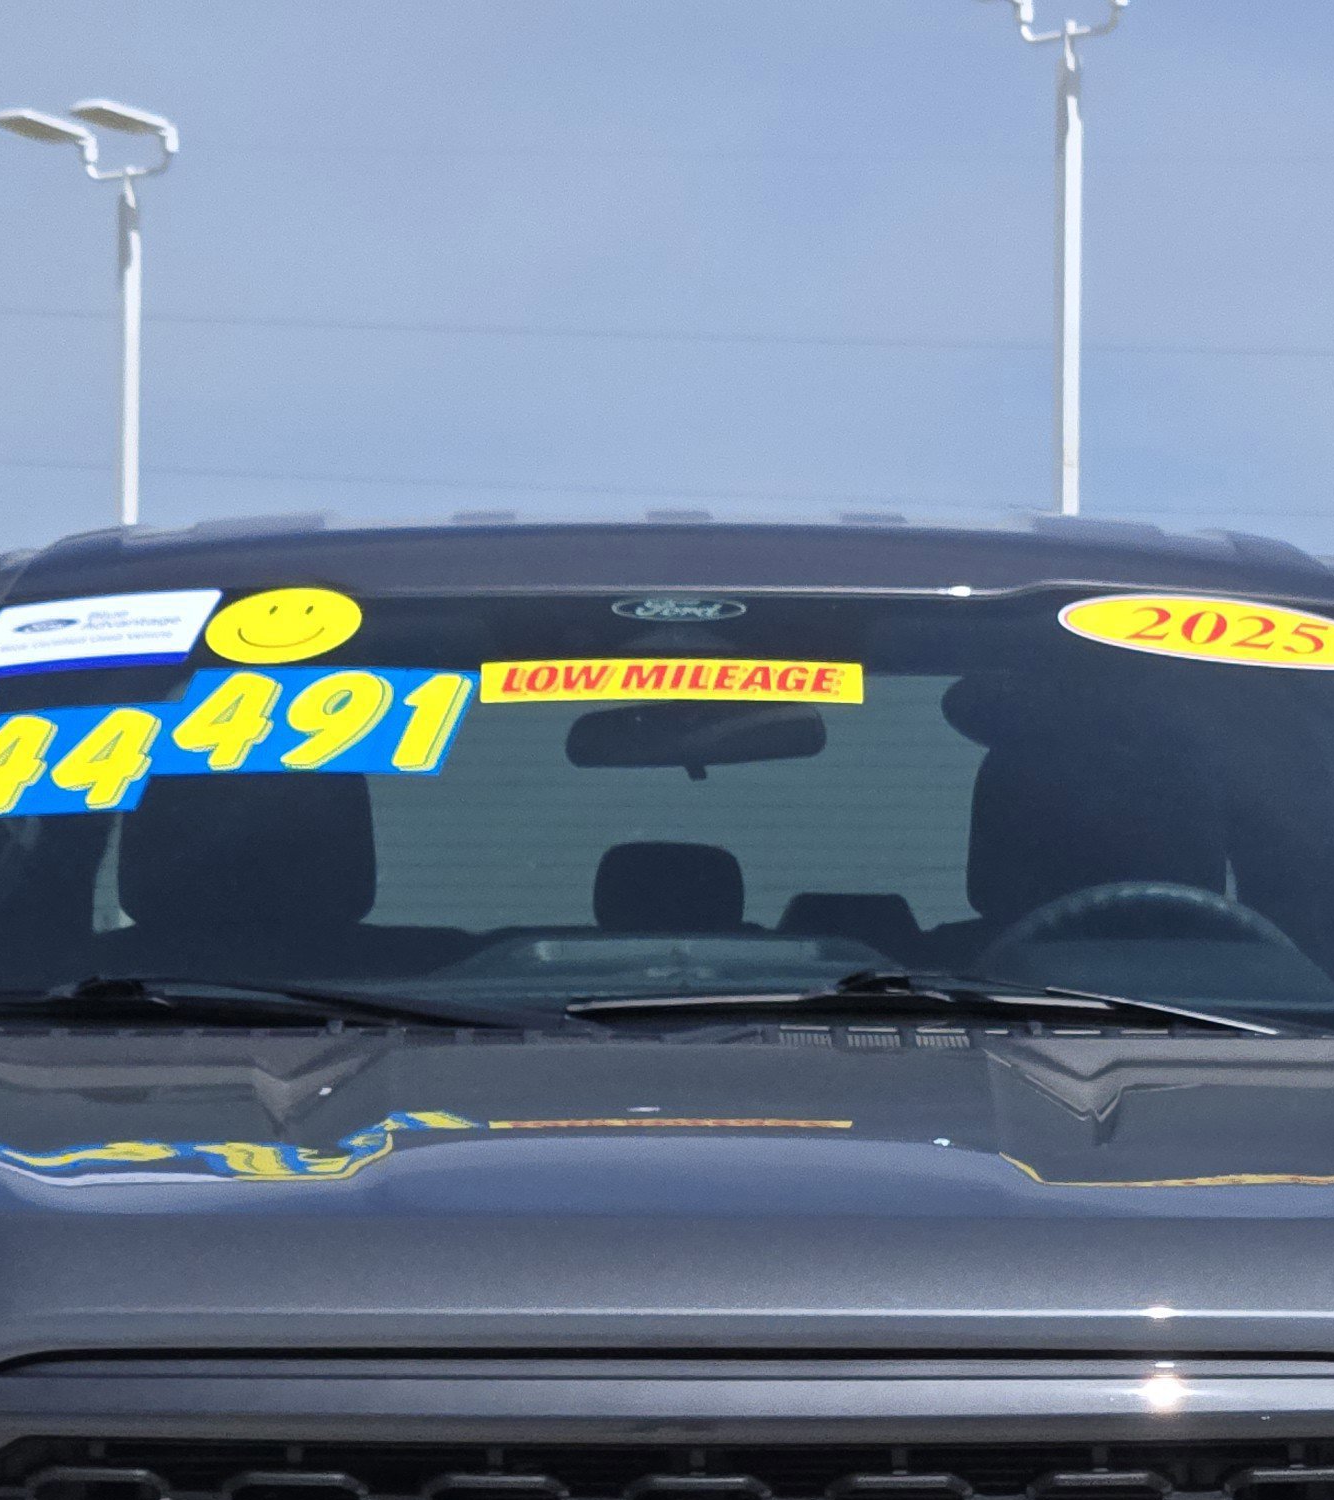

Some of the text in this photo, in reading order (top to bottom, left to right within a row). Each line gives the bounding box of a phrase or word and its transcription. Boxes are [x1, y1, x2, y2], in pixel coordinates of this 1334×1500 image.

[635, 599, 723, 620] Ford
[1126, 606, 1330, 656] 2025
[502, 664, 843, 695] LOW MILEAGE
